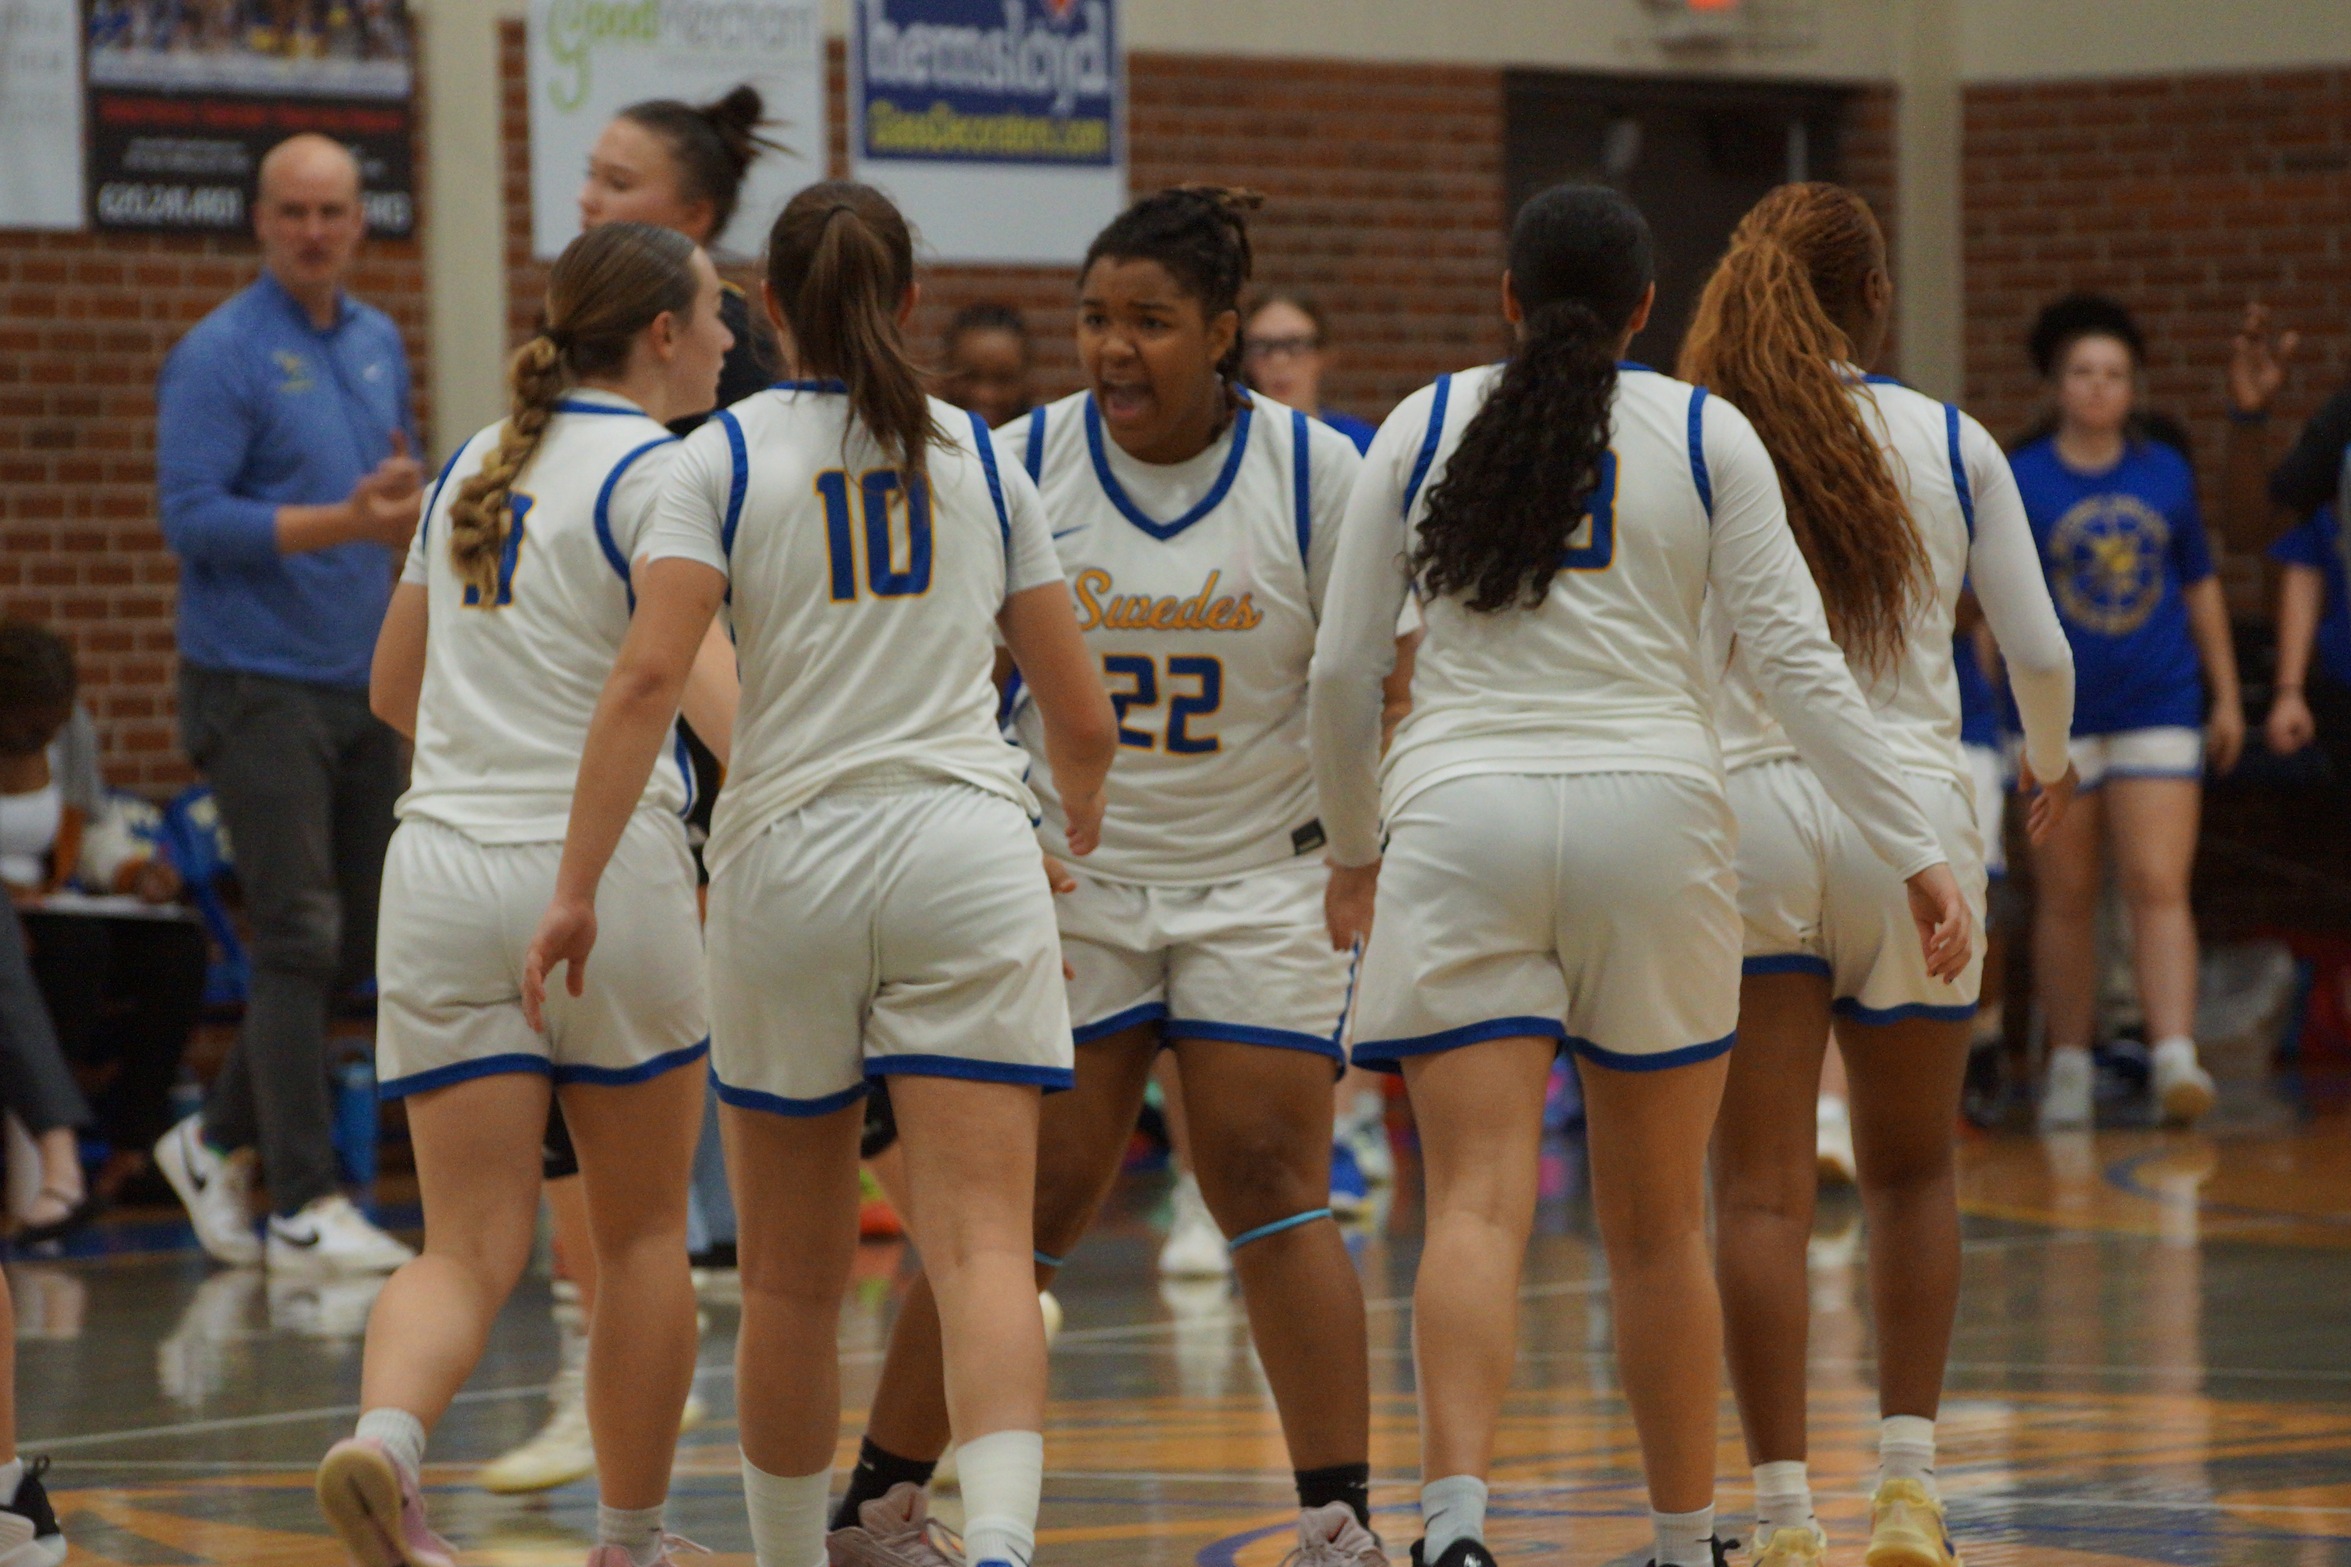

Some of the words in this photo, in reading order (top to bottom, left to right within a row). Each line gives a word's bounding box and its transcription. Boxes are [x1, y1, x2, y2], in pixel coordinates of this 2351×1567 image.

[814, 467, 935, 604] 10
[1074, 567, 1264, 632] Swedes
[1100, 652, 1223, 756] 22
